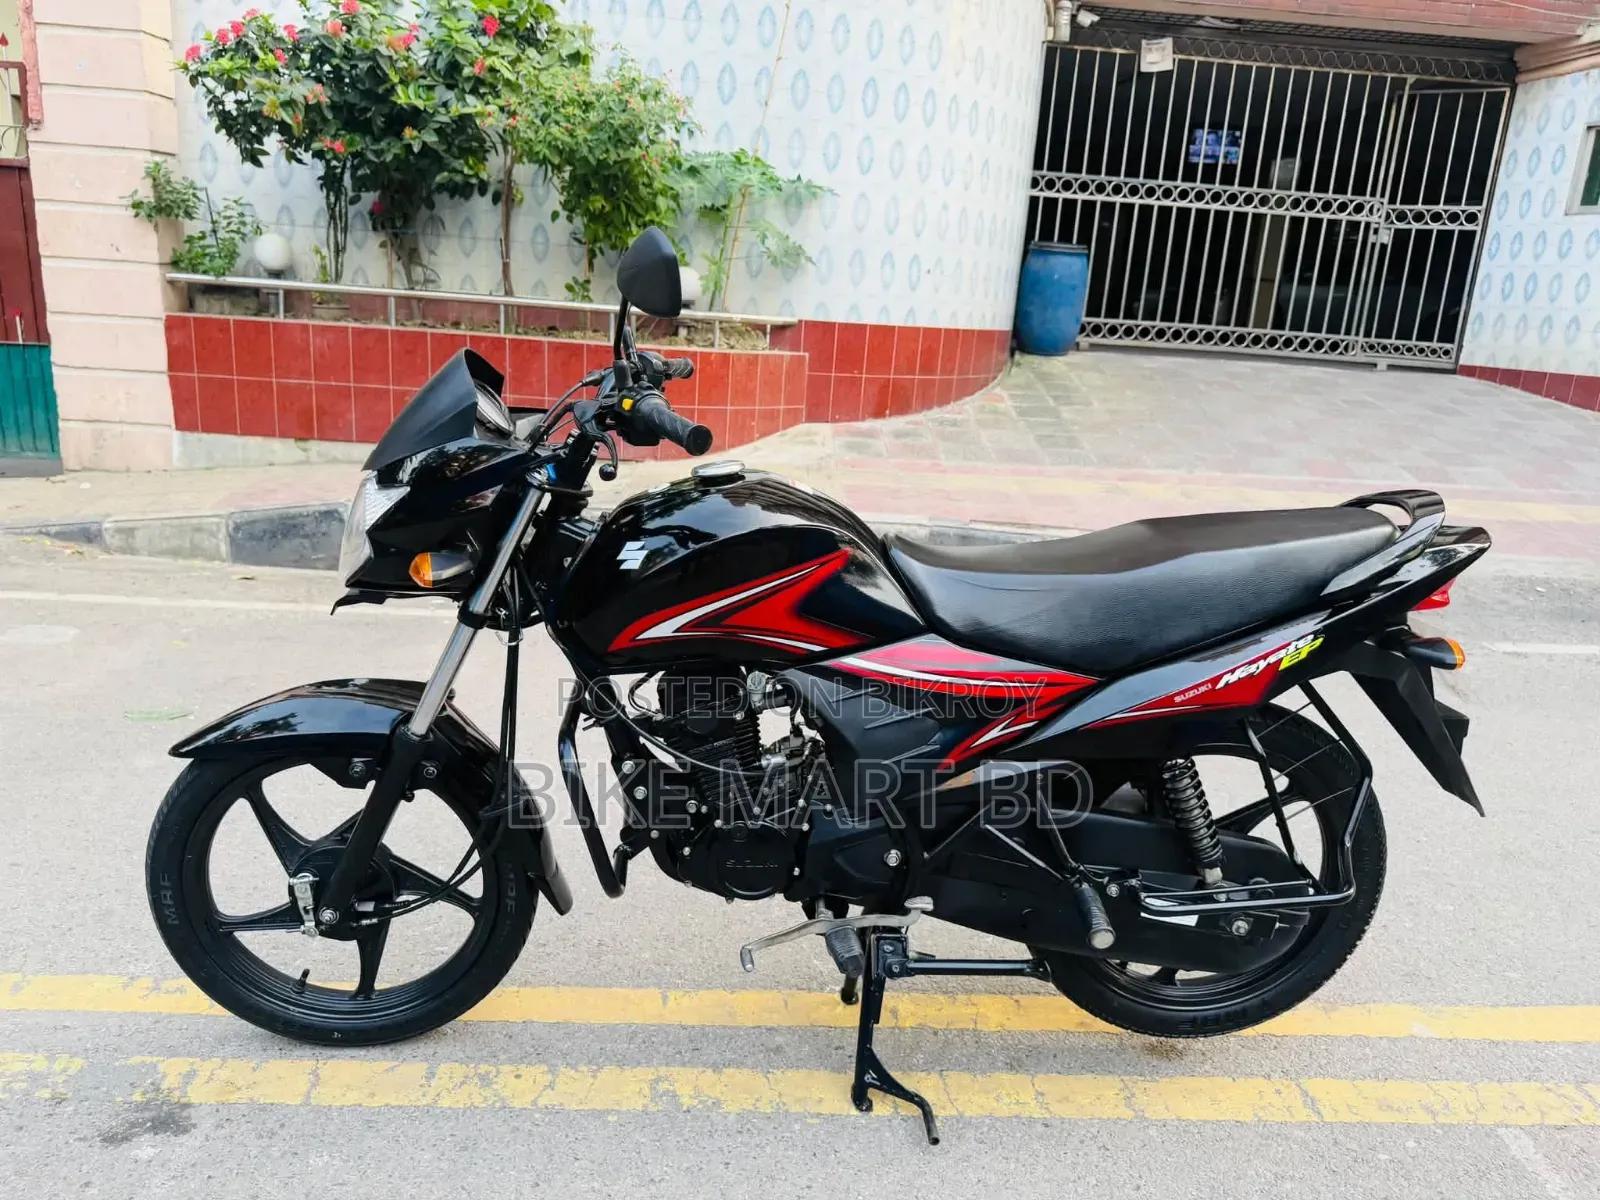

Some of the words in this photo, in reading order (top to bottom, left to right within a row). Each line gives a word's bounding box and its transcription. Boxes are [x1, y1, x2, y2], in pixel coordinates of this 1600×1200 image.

[1174, 683, 1212, 702] SUZUKI
[1215, 634, 1314, 690] Hayate
[1278, 637, 1324, 671] EP
